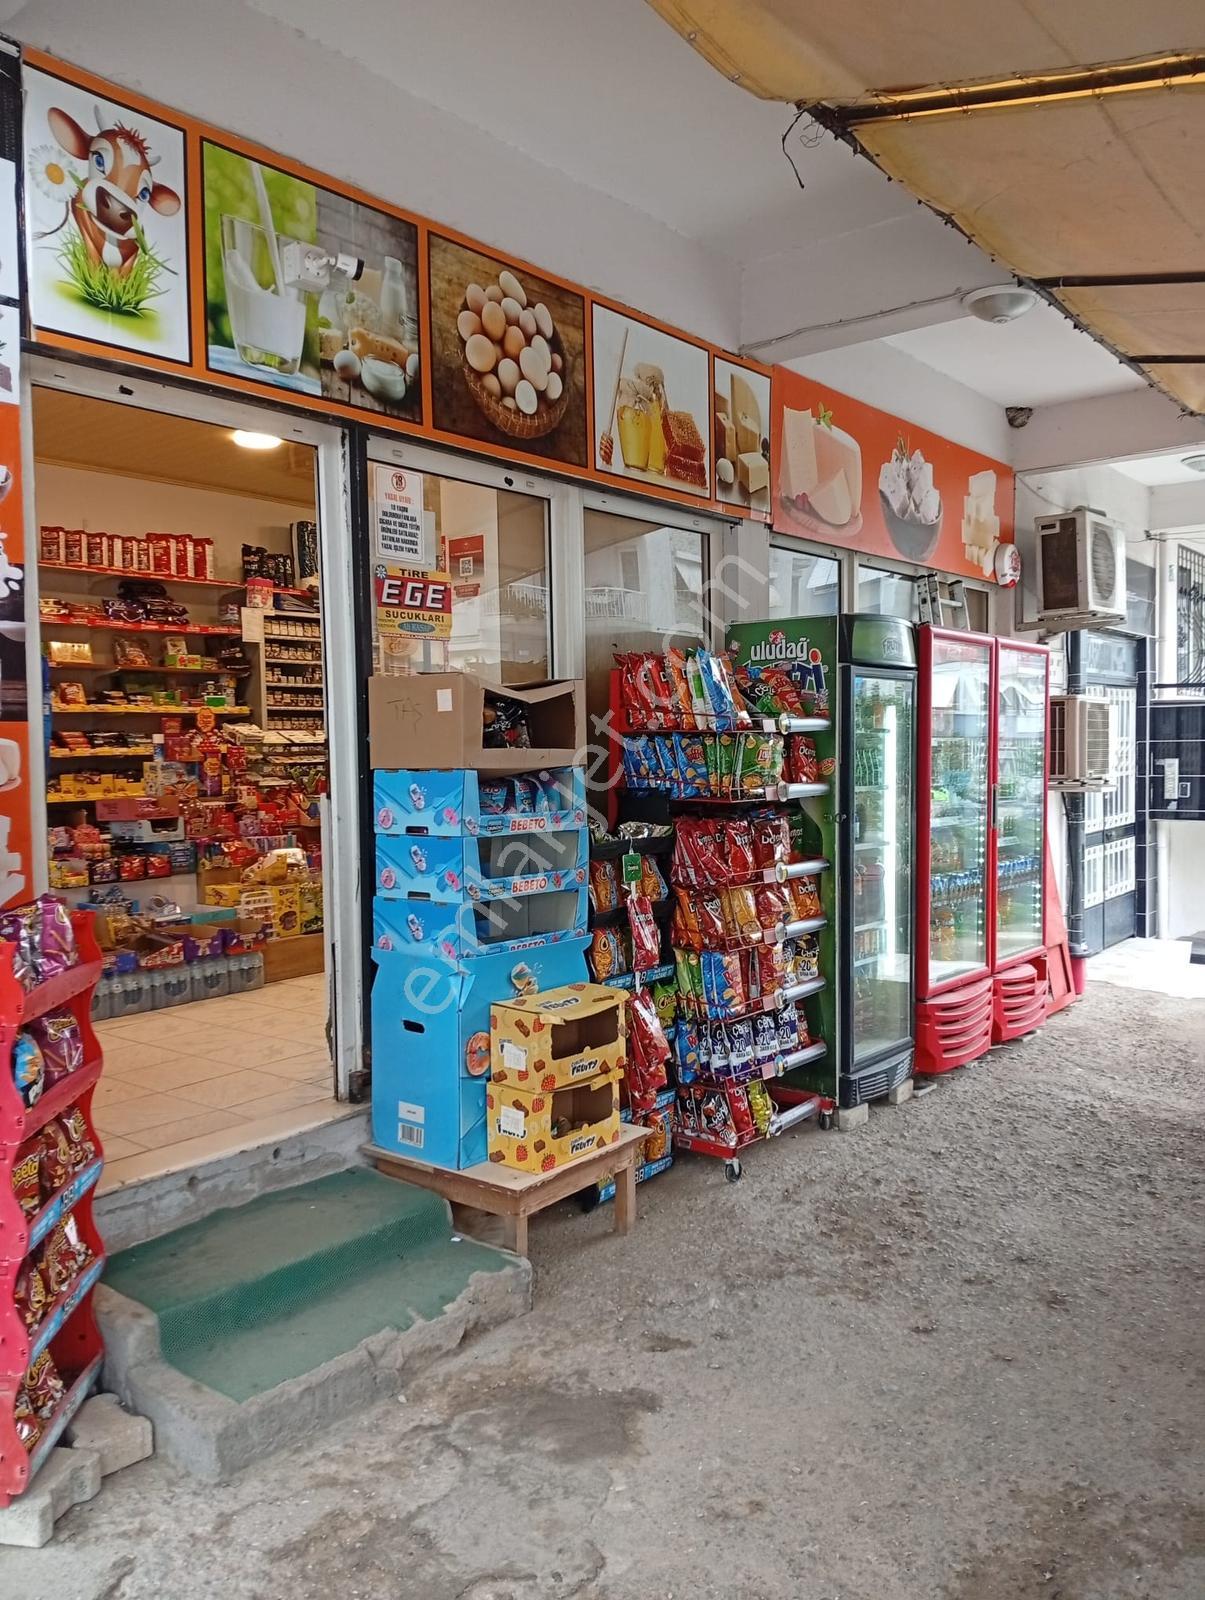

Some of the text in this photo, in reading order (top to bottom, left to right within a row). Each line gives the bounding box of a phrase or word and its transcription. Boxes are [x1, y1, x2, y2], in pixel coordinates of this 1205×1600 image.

[381, 579, 445, 609] EGE
[385, 610, 444, 623] SUCUKLARI
[750, 637, 809, 661] uludağ
[510, 816, 547, 832] BEBETO
[512, 878, 547, 894] BEBETO
